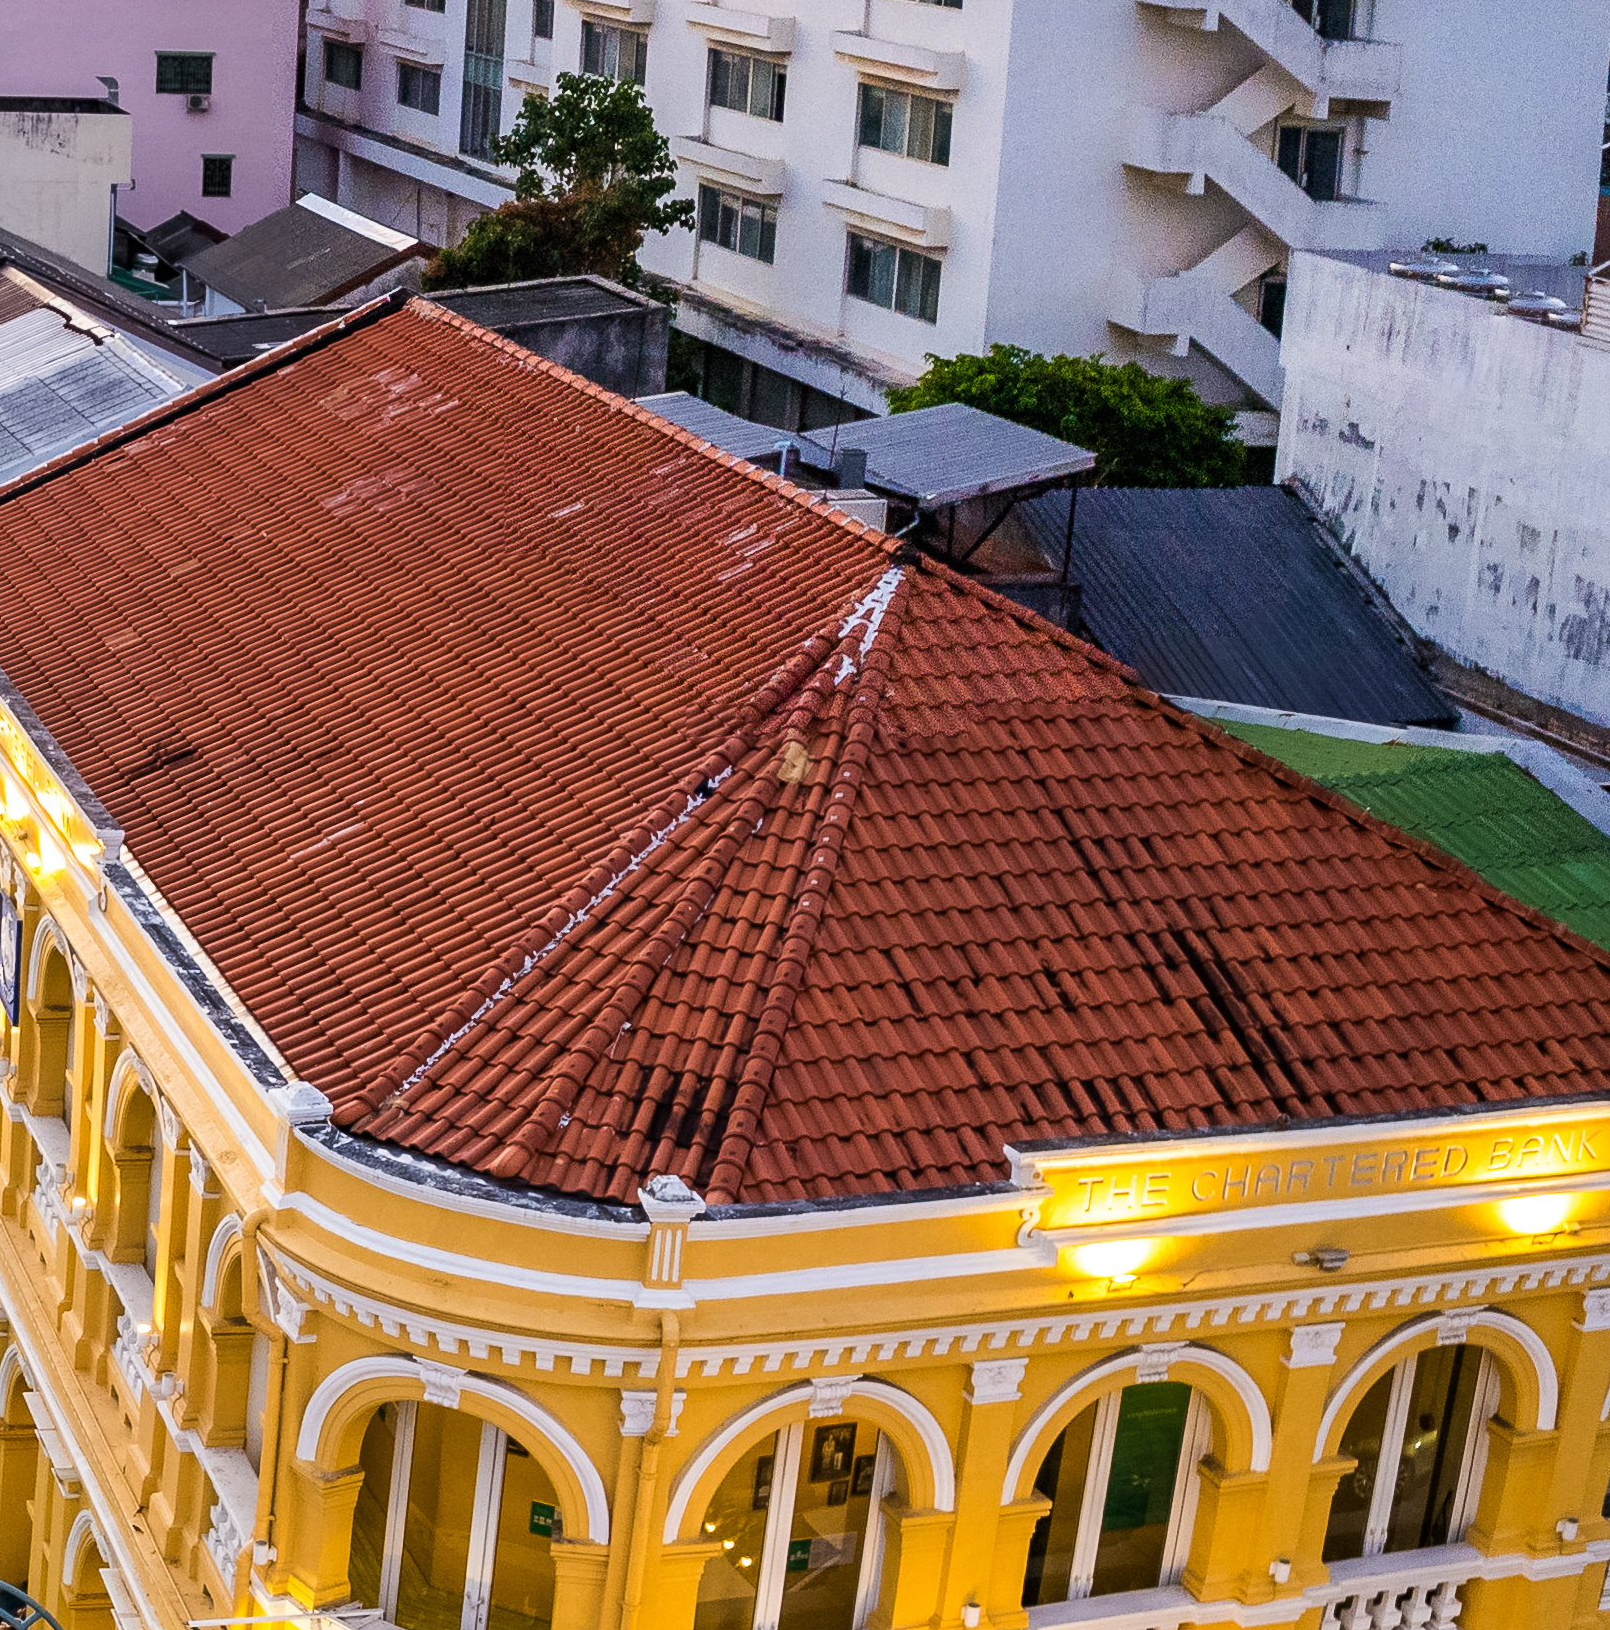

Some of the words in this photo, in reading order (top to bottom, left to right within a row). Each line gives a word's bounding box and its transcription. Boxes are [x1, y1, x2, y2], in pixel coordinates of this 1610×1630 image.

[1077, 1172, 1171, 1213] THE
[1191, 1145, 1468, 1201] CHARTERED
[1487, 1129, 1600, 1172] BANK
